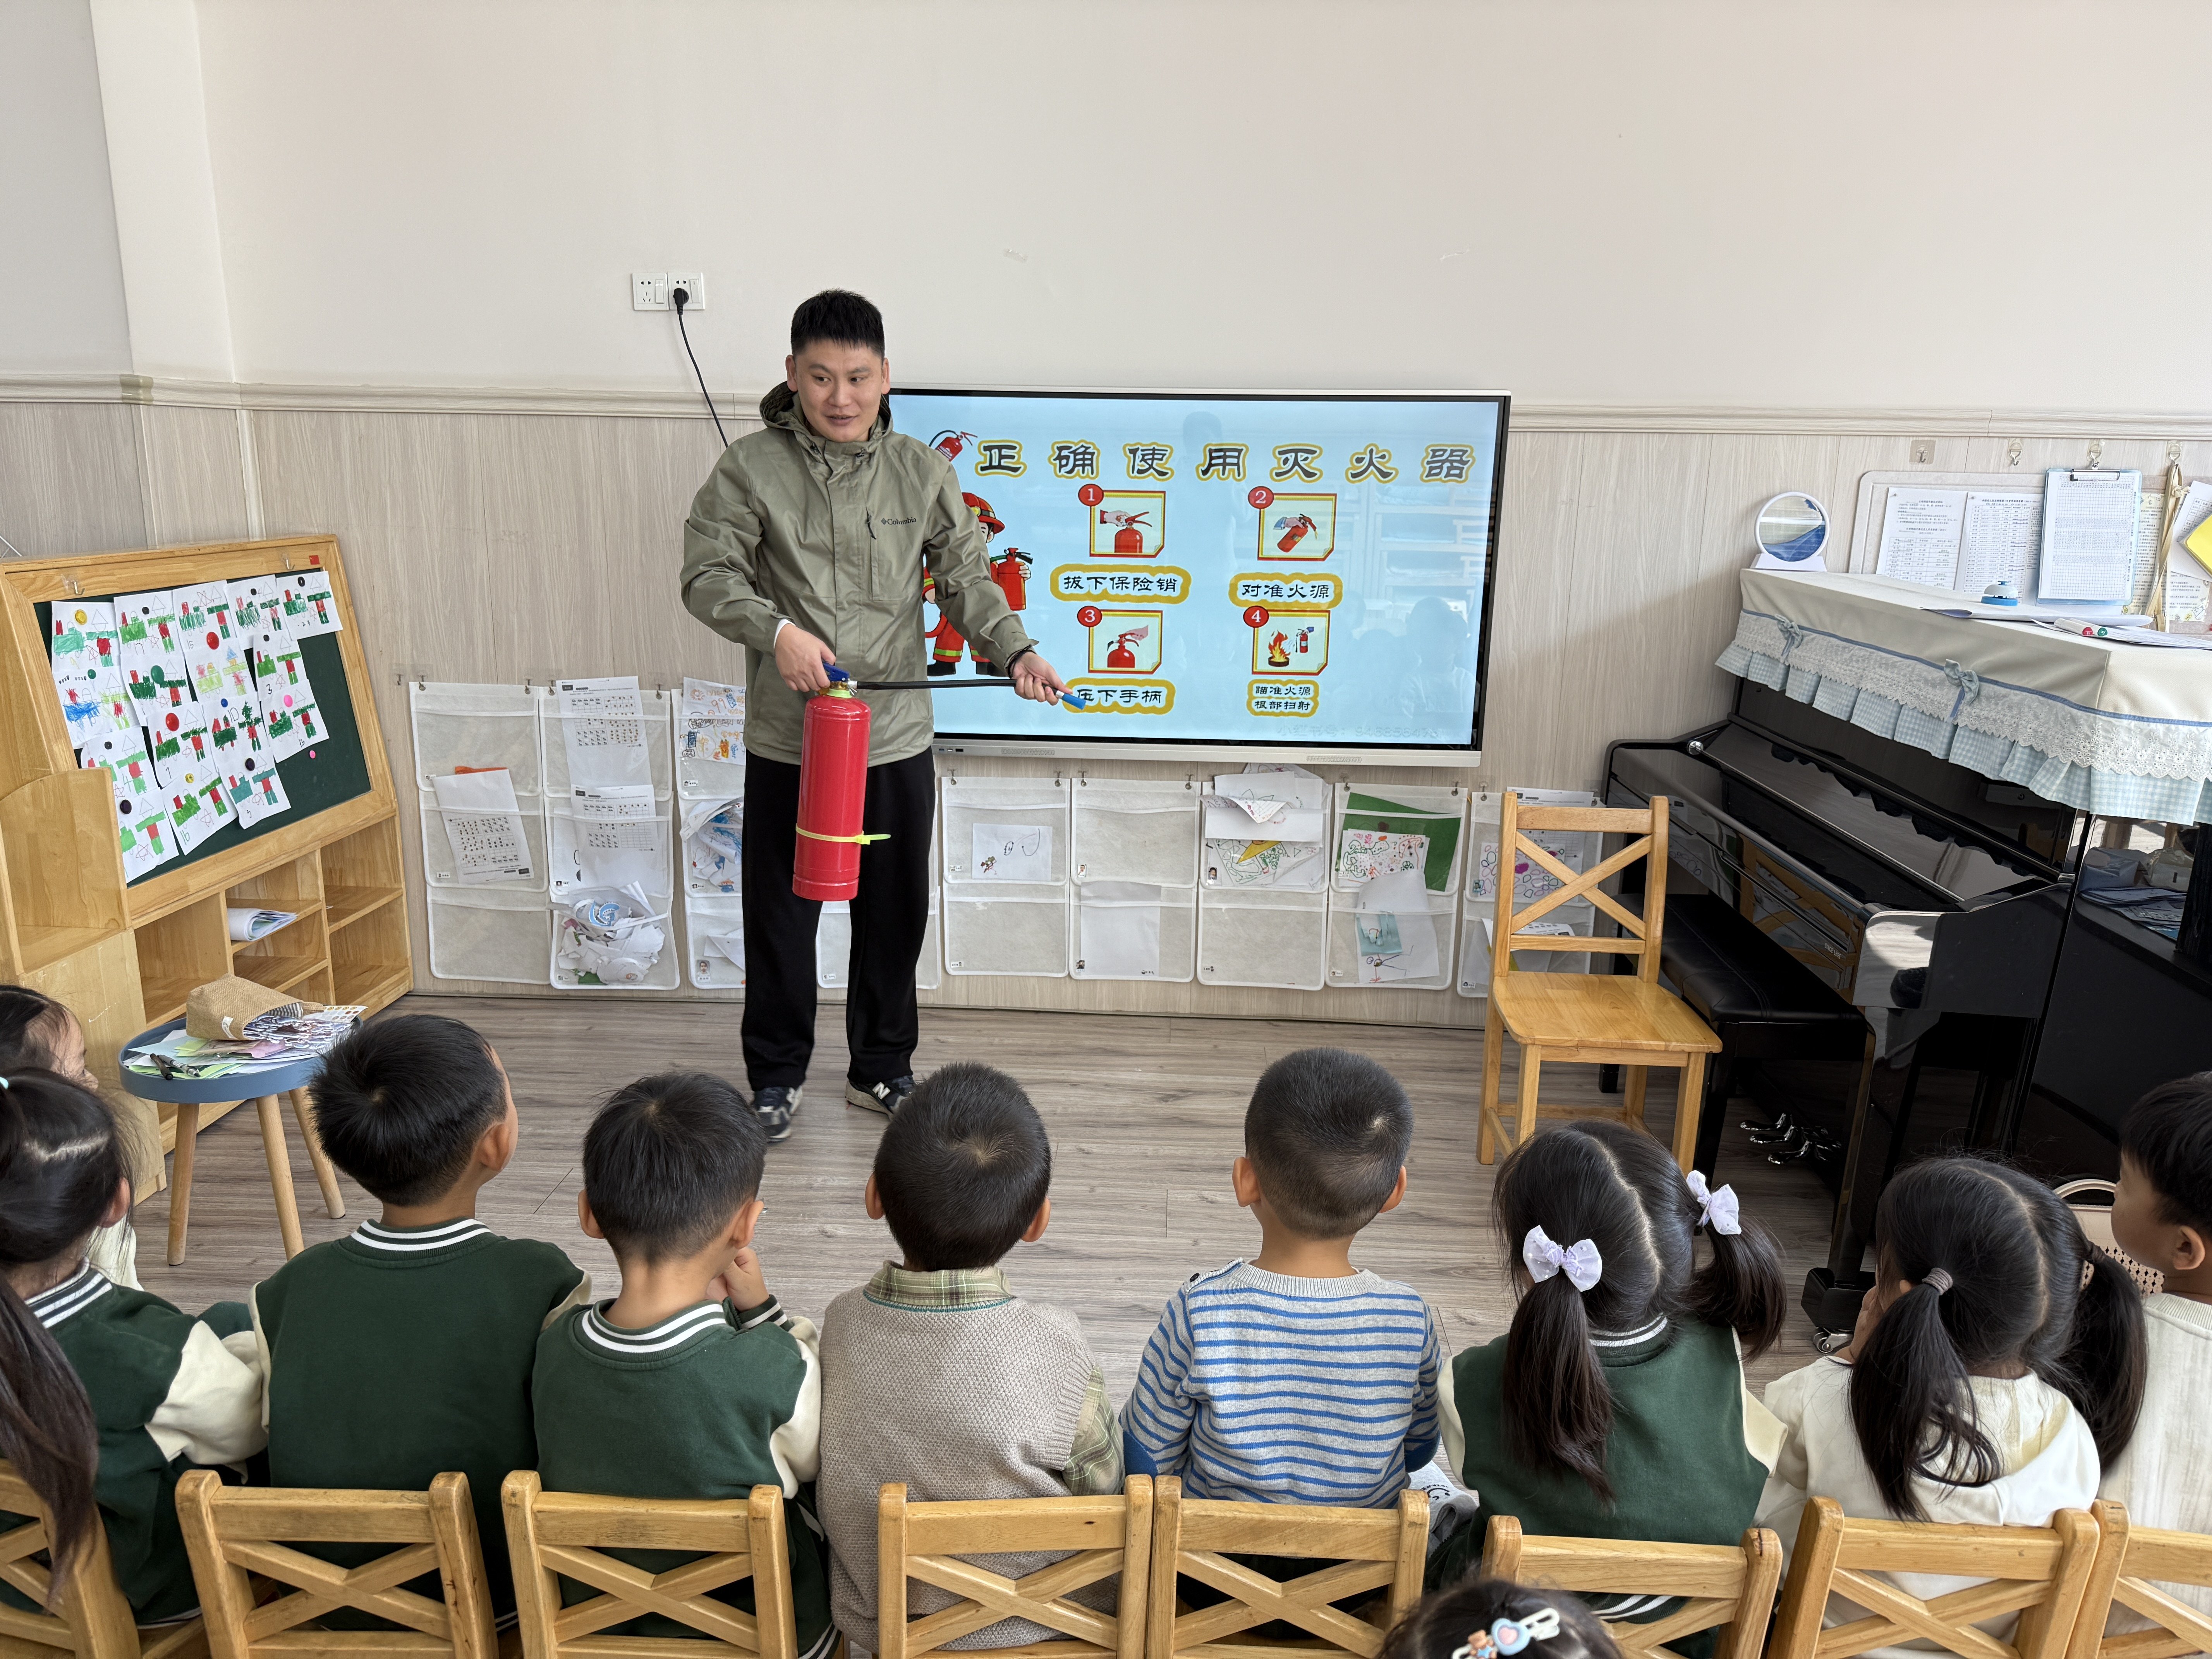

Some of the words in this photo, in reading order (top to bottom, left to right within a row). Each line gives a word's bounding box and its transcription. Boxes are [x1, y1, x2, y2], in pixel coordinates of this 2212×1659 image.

[980, 444, 1471, 479] 正确使用灭火器
[1088, 488, 1095, 501] 1
[1256, 490, 1266, 504] 2
[1064, 575, 1177, 592] 拔下保险销
[1242, 584, 1329, 599] 对准火源
[1085, 610, 1095, 622] 3
[1251, 610, 1261, 622] 4
[266, 684, 272, 694] 3
[1255, 686, 1311, 696] 瞄准火源
[1077, 689, 1162, 704] 压下手柄
[1255, 701, 1310, 711] 根部扫射
